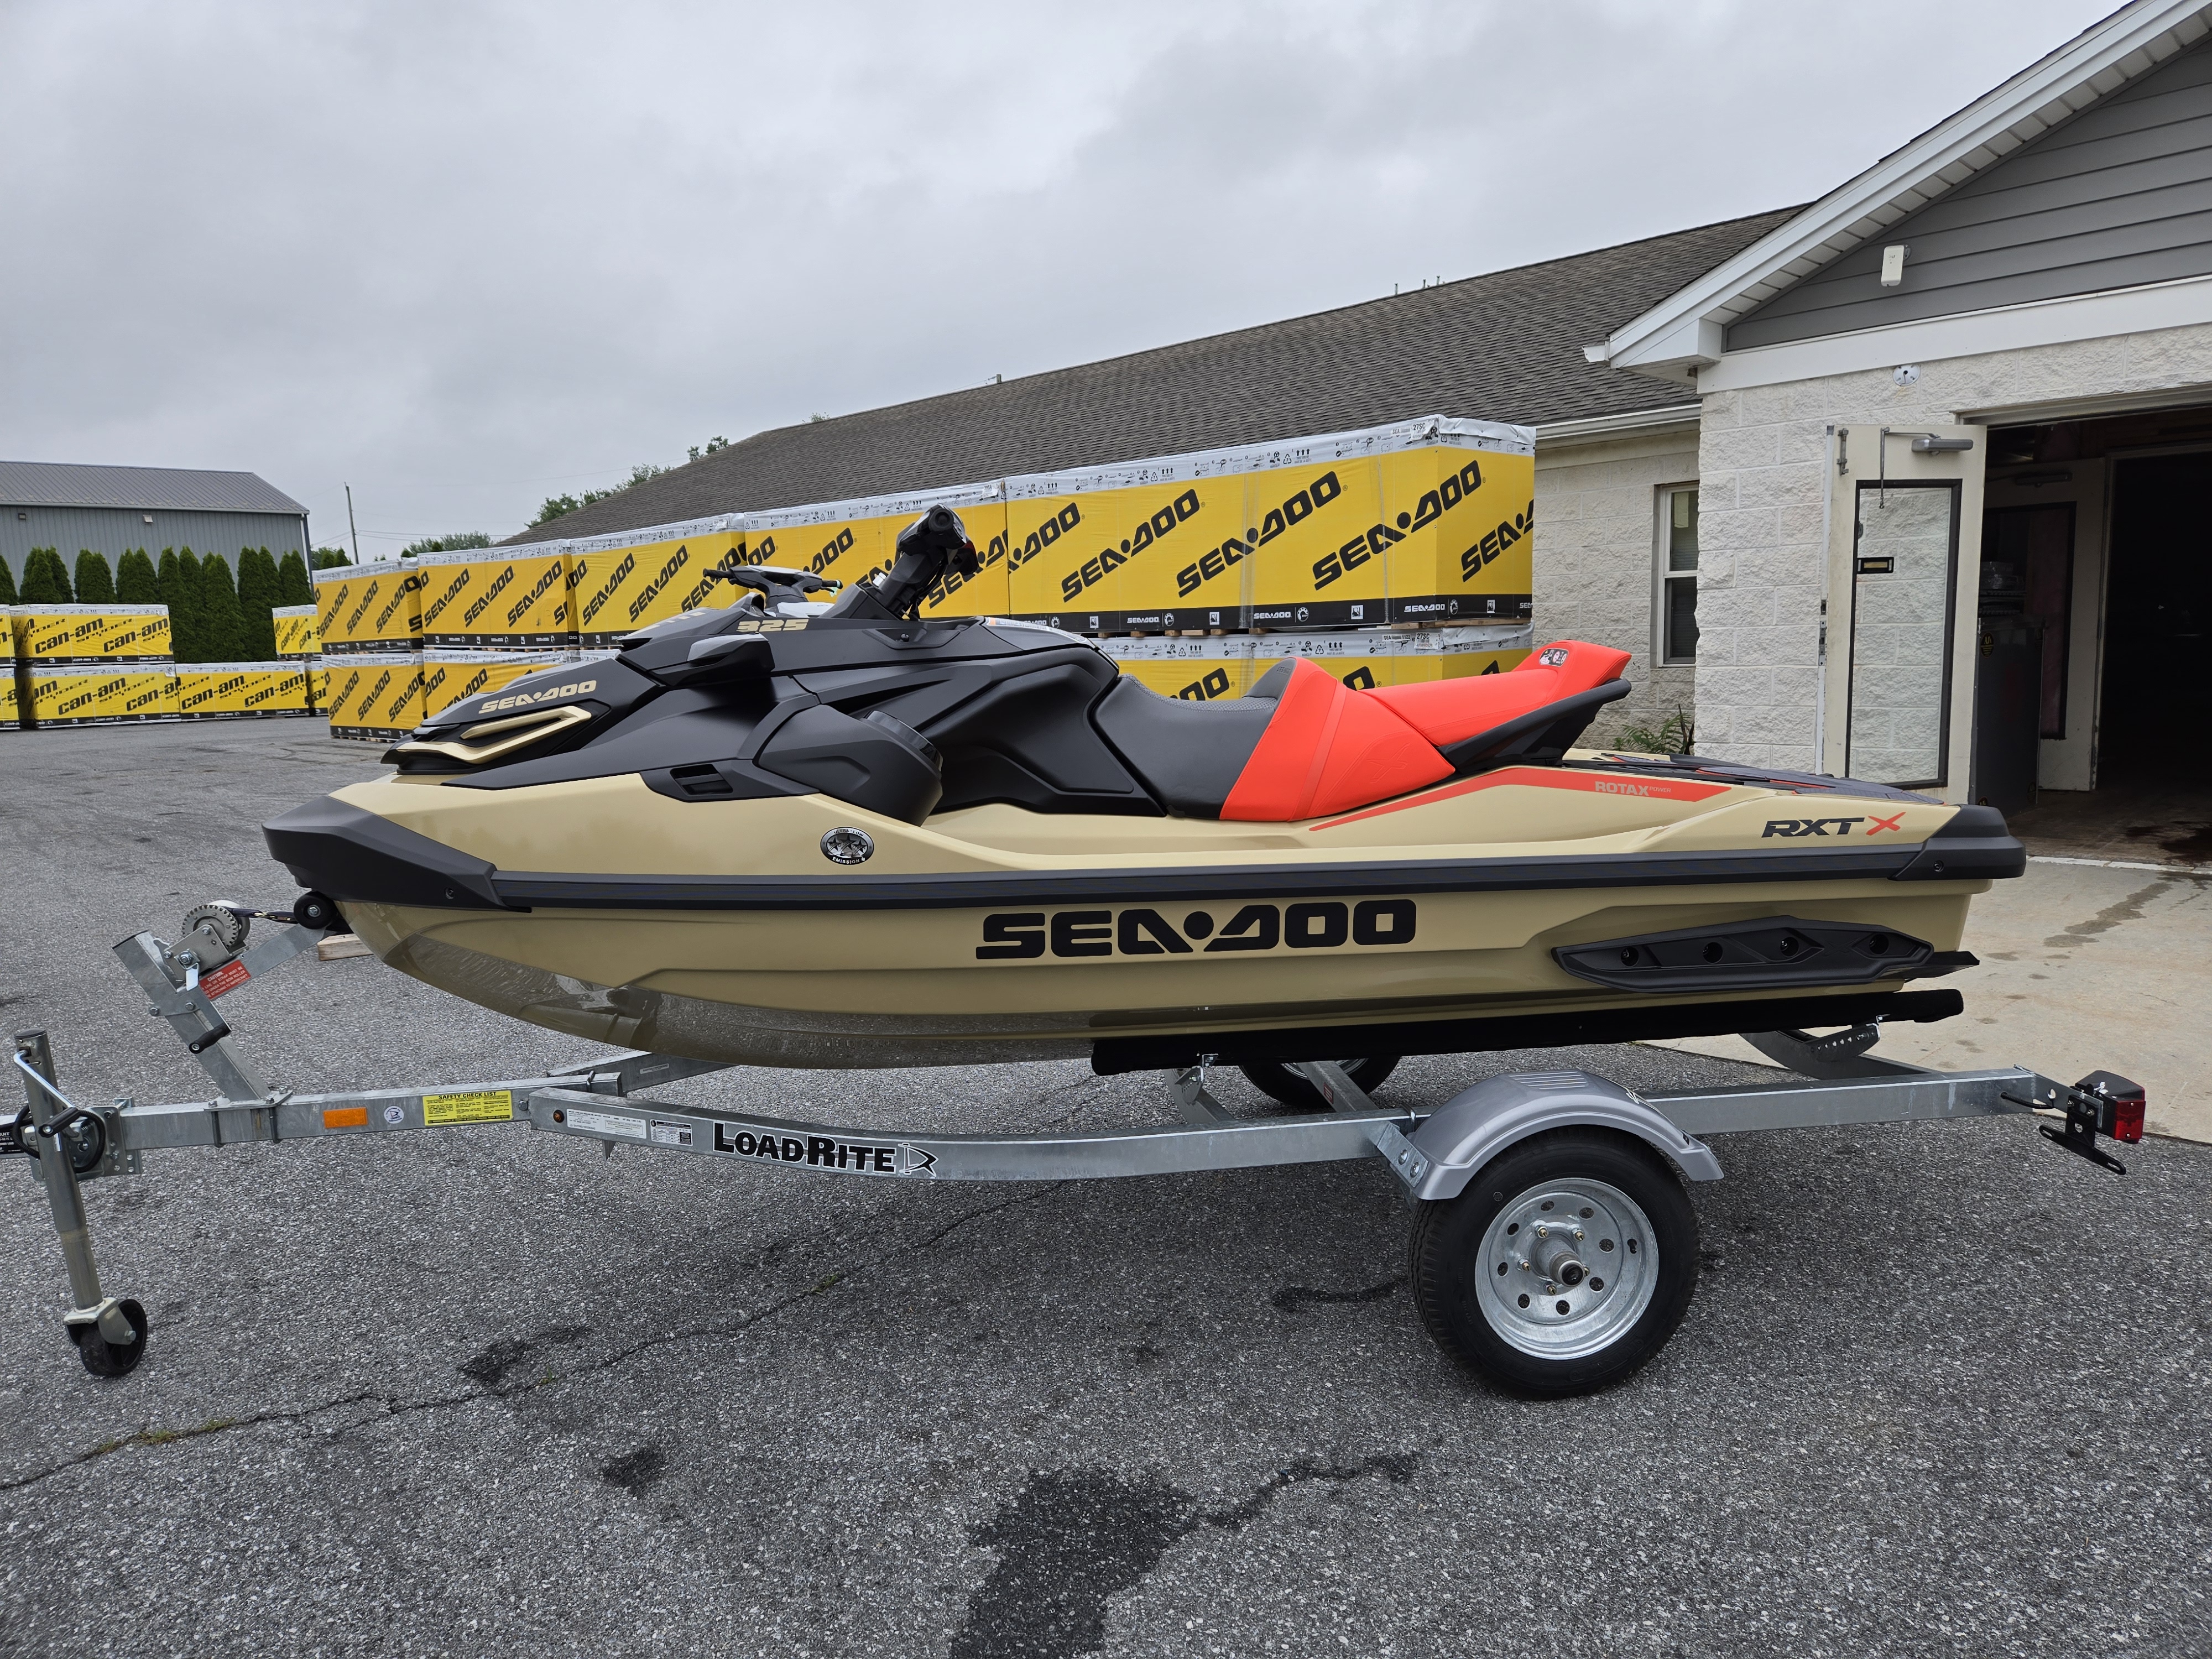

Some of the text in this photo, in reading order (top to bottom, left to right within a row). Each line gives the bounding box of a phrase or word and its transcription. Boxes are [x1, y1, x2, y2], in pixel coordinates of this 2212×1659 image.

[35, 618, 103, 654] can-am
[103, 618, 169, 653] can-am
[737, 619, 808, 633] 325
[58, 677, 126, 716] can-am
[182, 675, 244, 710] can-am
[244, 674, 304, 708] can-am
[1595, 781, 1649, 796] ROTAX
[1761, 812, 1906, 838] RXT X
